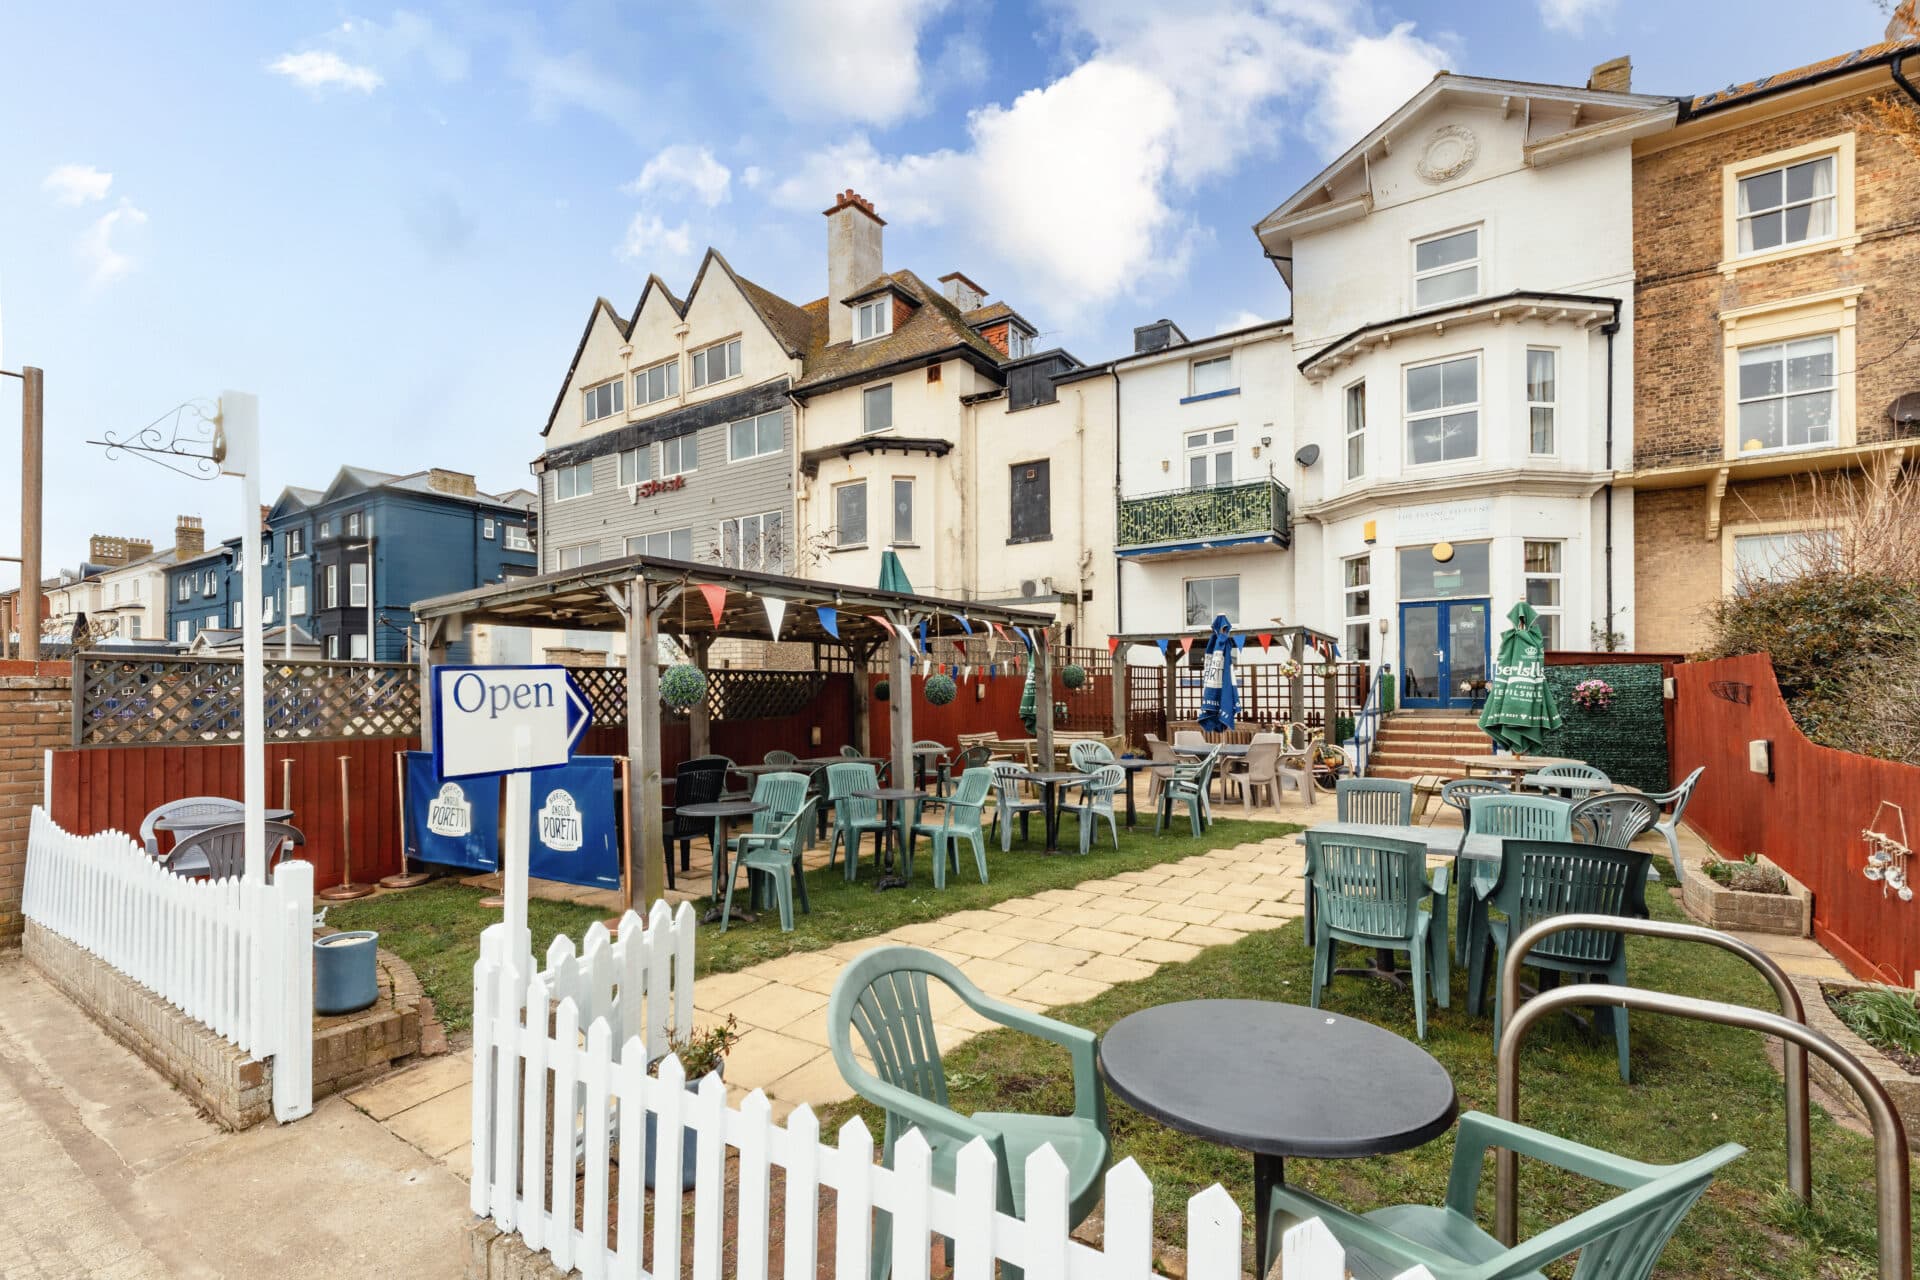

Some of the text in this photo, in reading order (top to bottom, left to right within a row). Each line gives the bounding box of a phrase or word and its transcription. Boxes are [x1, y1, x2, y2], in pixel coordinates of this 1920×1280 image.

[453, 673, 554, 718] Open
[432, 805, 467, 828] PORETTI
[543, 816, 578, 841] PORETTI
